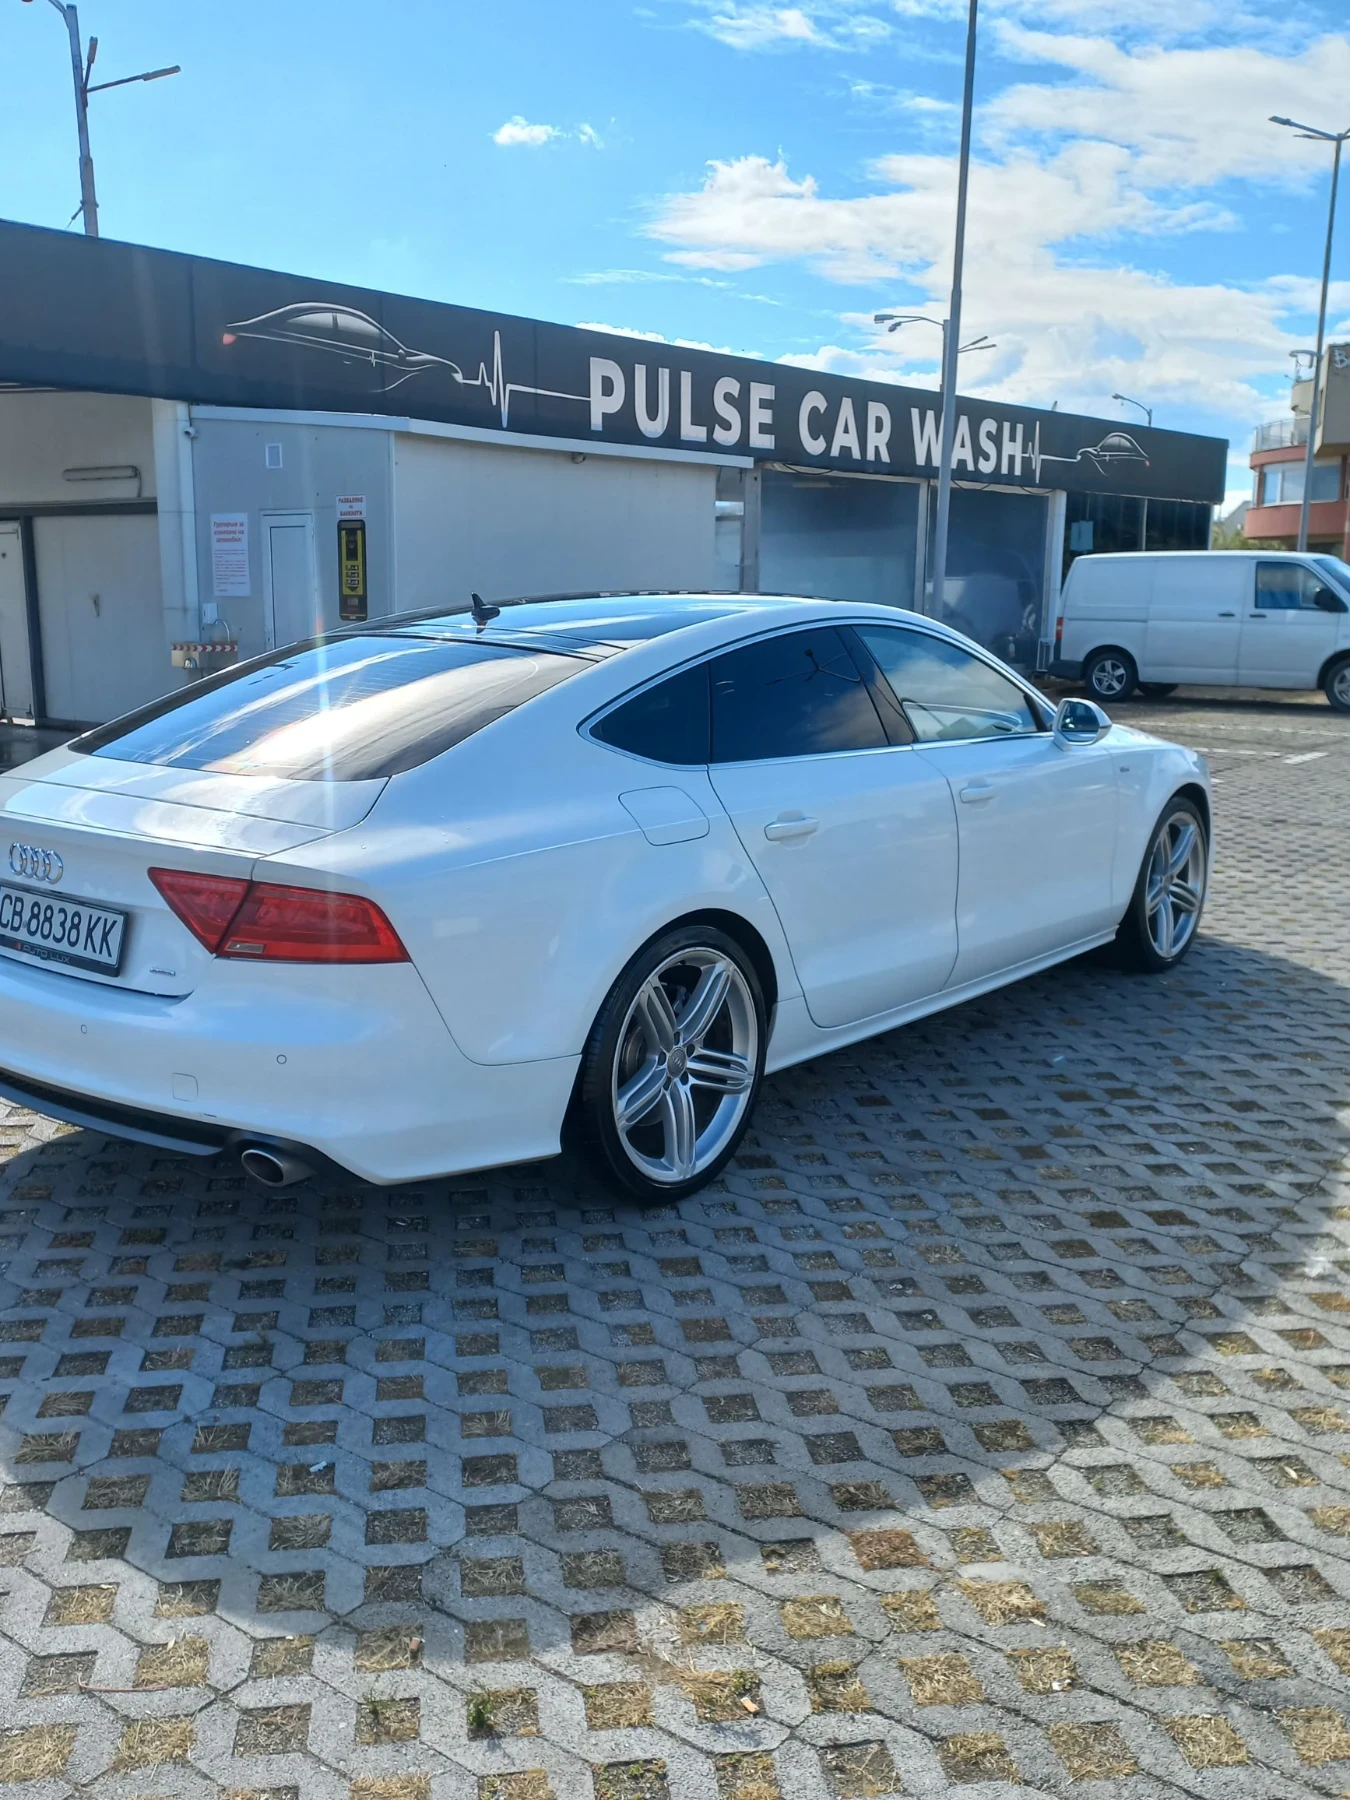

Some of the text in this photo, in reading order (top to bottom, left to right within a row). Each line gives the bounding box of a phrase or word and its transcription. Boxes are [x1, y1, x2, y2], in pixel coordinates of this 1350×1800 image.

[590, 357, 1024, 475] PULSE CAR WASH
[50, 952, 71, 964] LUX
